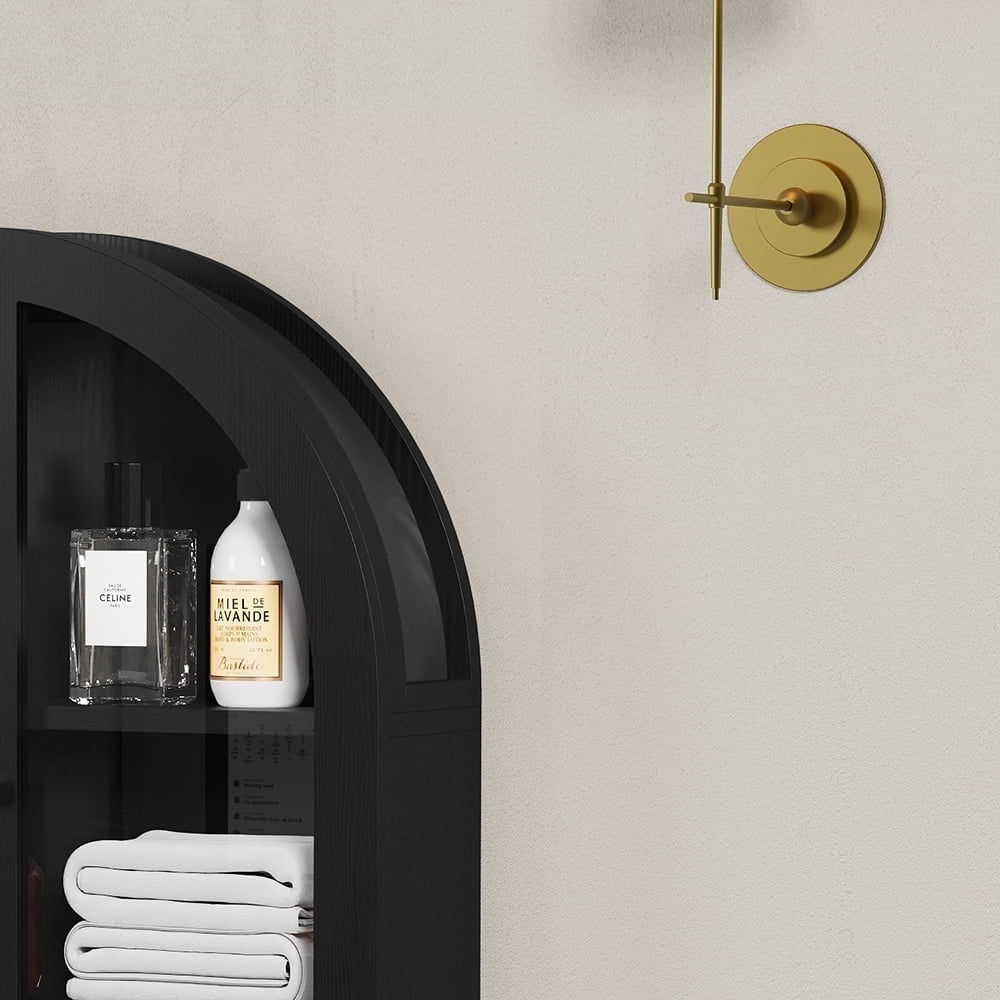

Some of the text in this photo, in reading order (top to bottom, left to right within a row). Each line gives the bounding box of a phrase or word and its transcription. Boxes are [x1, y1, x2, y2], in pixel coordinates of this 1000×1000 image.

[99, 594, 132, 602] CELINE
[217, 598, 248, 610] MIEL
[214, 610, 270, 623] LAVANDE
